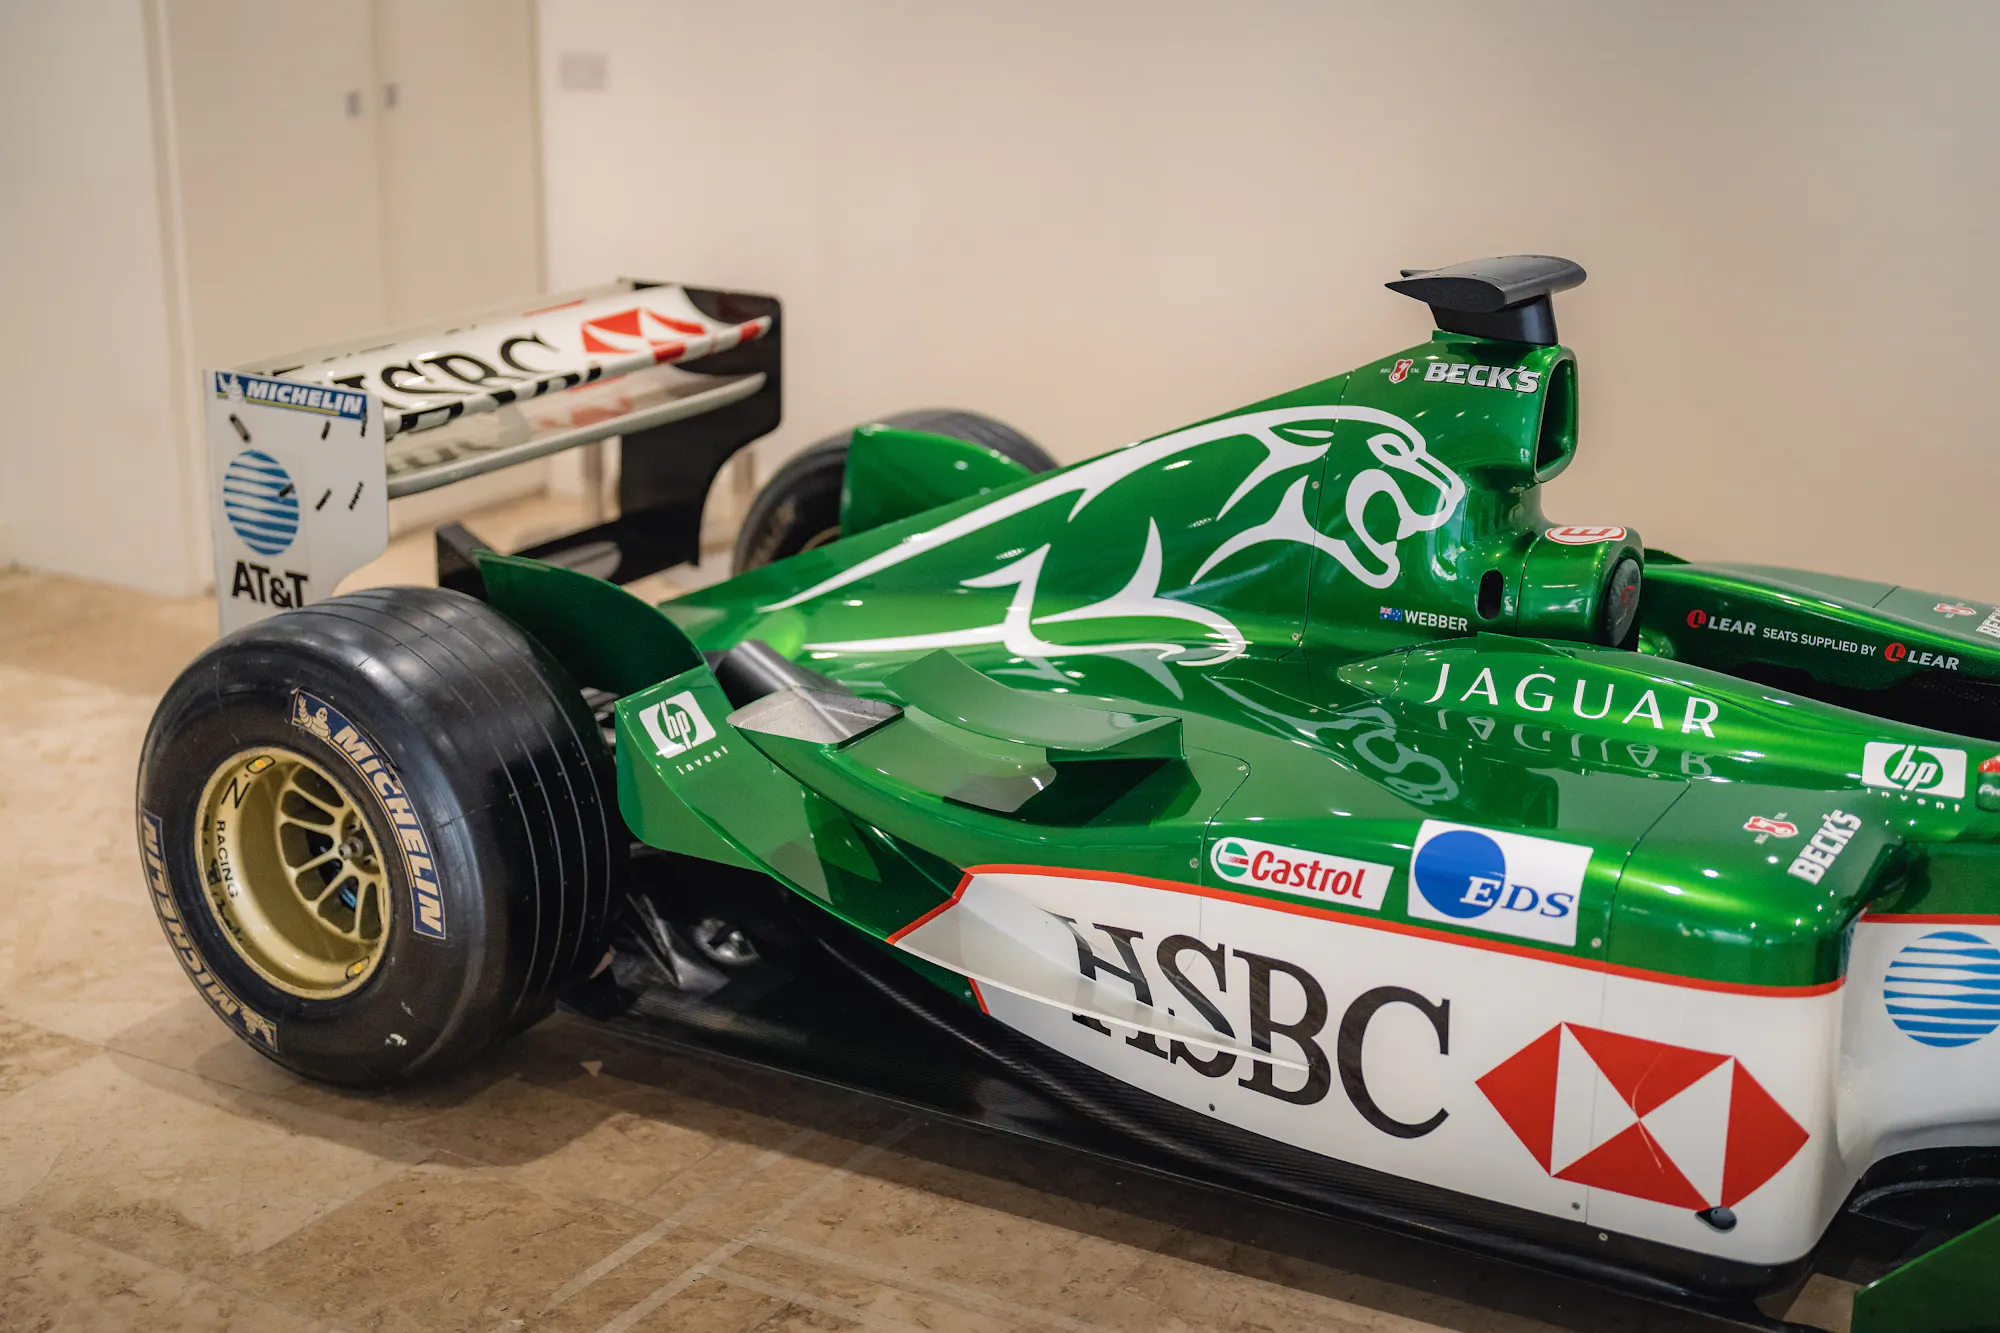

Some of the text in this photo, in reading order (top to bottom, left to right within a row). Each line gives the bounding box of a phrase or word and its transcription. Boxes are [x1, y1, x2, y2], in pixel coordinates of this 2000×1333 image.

[246, 379, 363, 415] MICHELIN
[1424, 362, 1540, 394] BECK'S
[232, 560, 309, 609] AT&T
[1404, 609, 1468, 632] WEBBER
[1708, 615, 1960, 671] LEAR SEATS SUPPLIED BY LEAR
[660, 700, 693, 750] hp
[1423, 663, 1719, 739] JAGUAR
[675, 745, 729, 775] invent
[1890, 744, 1939, 791] hp
[332, 725, 443, 933] MICHELIN
[1787, 809, 1862, 885] BECK'S
[216, 820, 239, 899] RACING
[1251, 850, 1367, 900] Castrol
[142, 815, 239, 1017] MICHELIN
[1460, 876, 1575, 918] EDS
